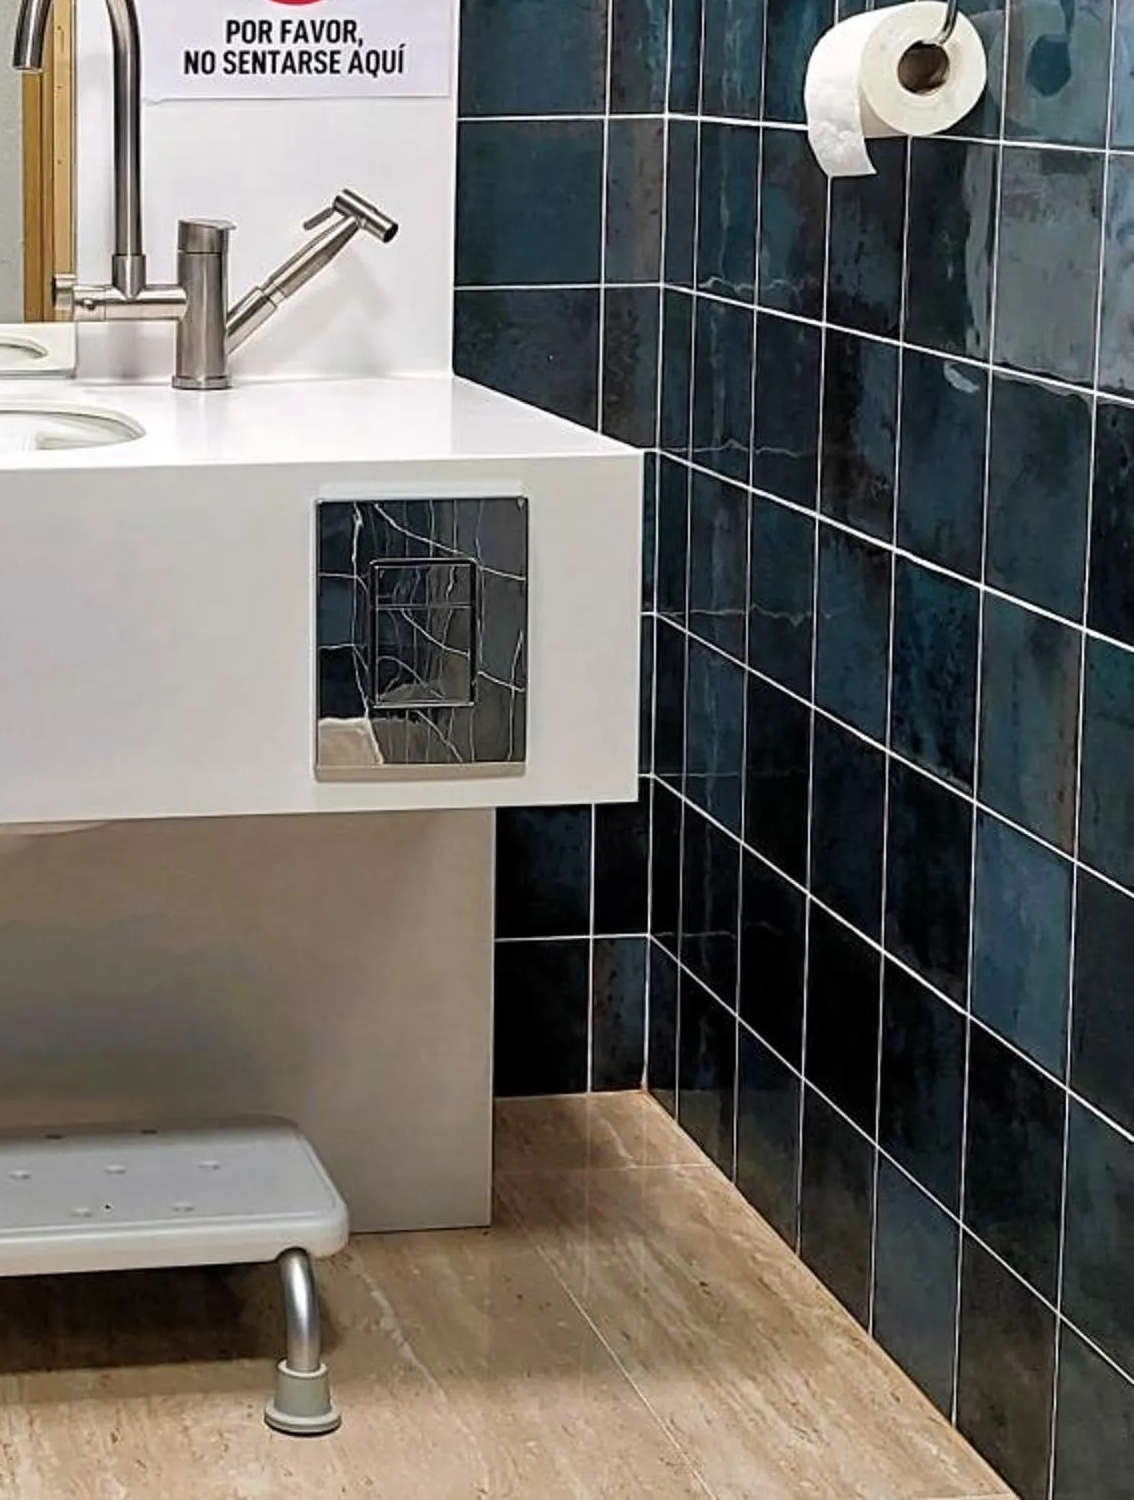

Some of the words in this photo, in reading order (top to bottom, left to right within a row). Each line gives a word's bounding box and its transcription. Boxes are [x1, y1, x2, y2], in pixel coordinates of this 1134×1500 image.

[225, 19, 273, 44] POR
[280, 19, 364, 47] FAVOR,
[183, 50, 216, 75] NO
[222, 50, 341, 75] SENTARSE
[347, 43, 406, 78] AQUÍ
